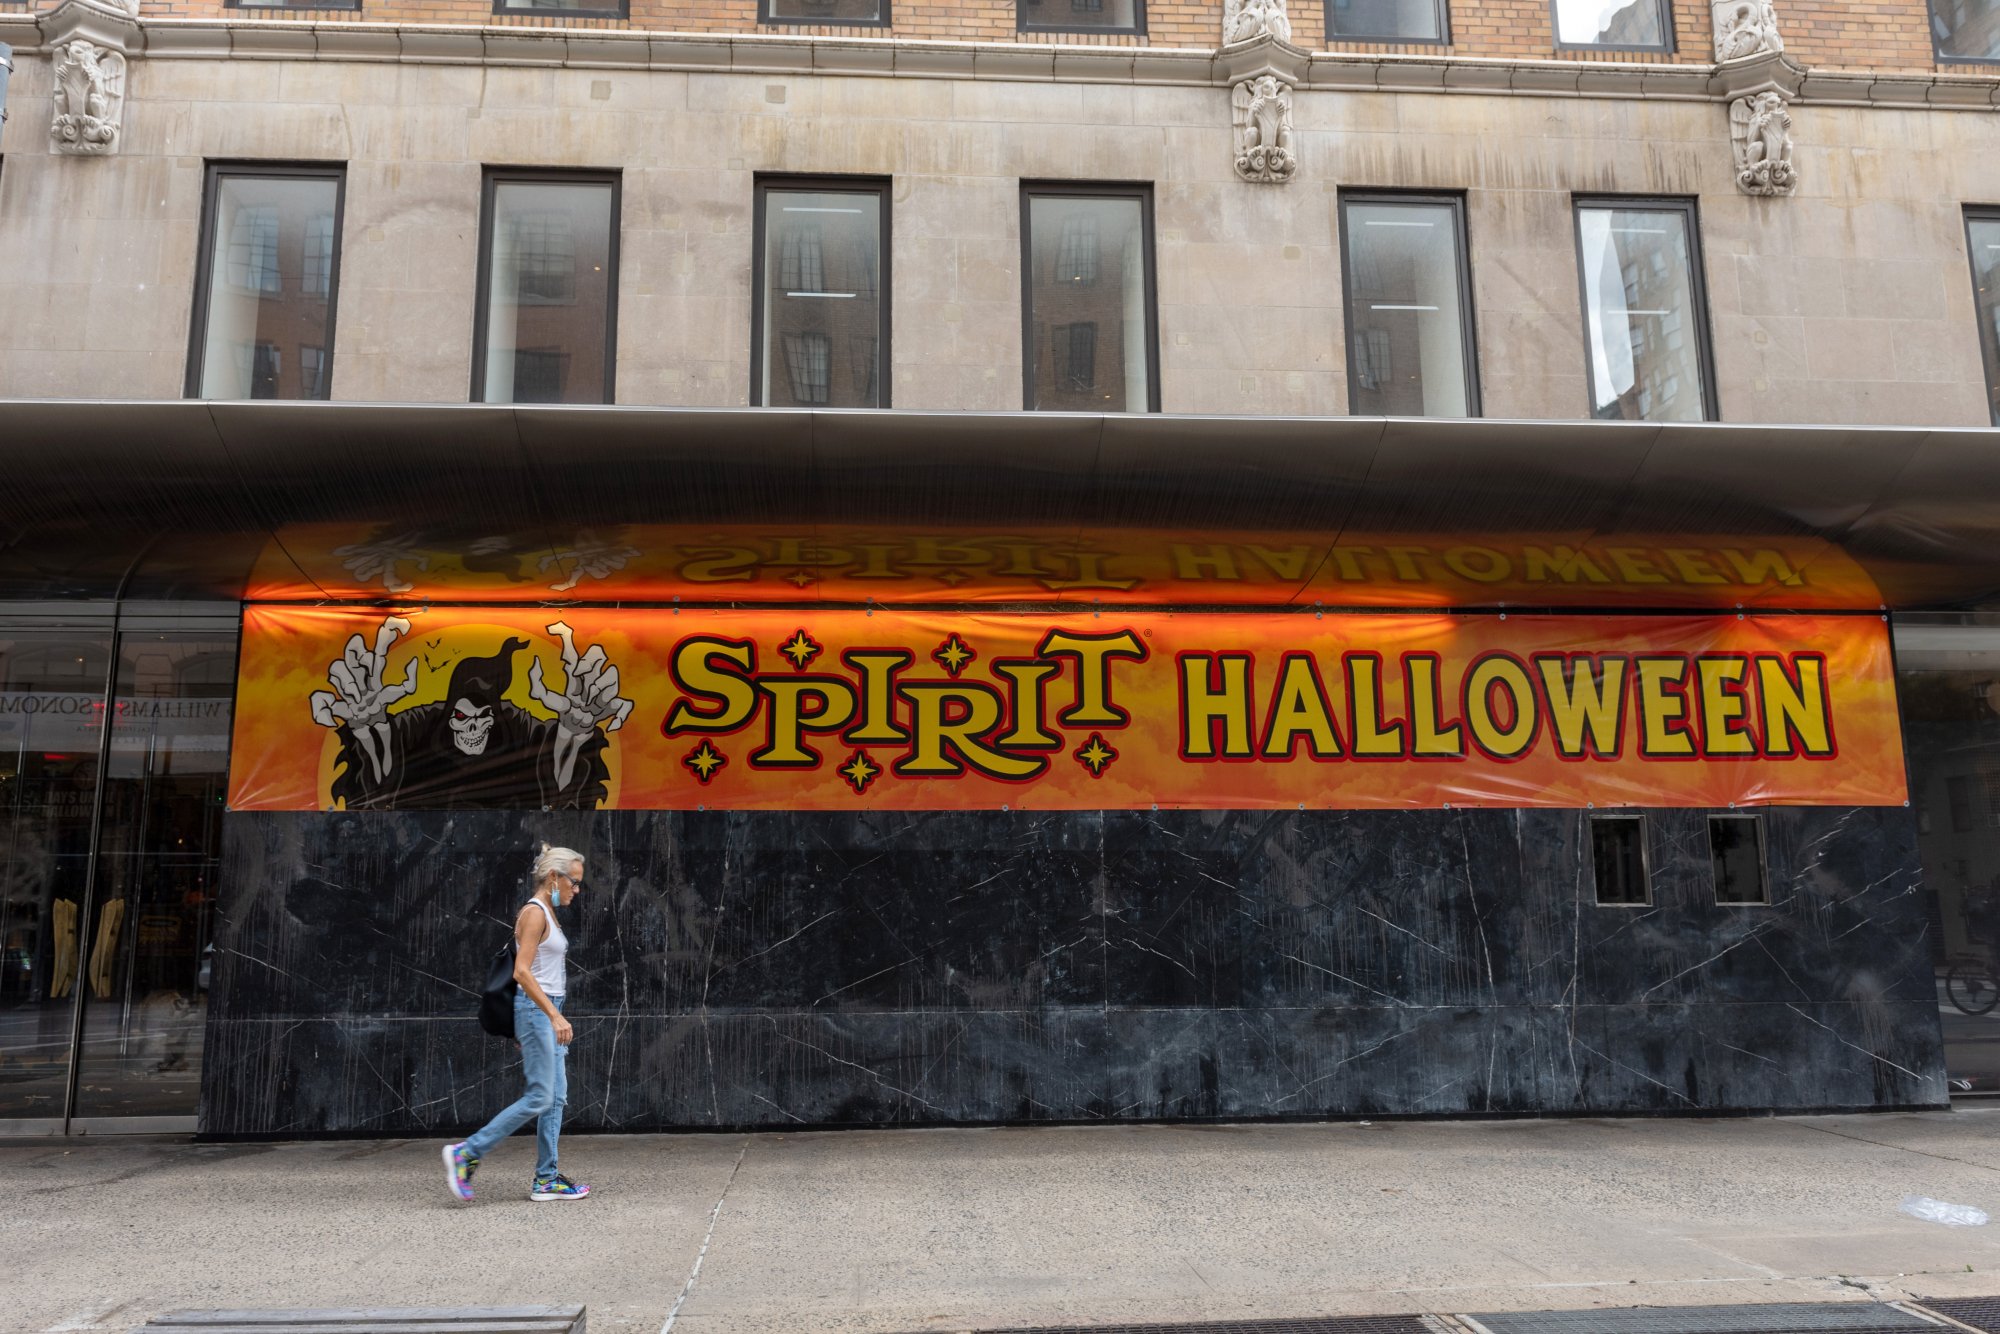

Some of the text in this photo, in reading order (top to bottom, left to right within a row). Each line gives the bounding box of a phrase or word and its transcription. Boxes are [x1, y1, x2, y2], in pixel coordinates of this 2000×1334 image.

[662, 630, 1838, 781] SPIRIT HALLOWEEN
[79, 791, 114, 804] UNIL
[41, 804, 114, 818] HALLOWN
